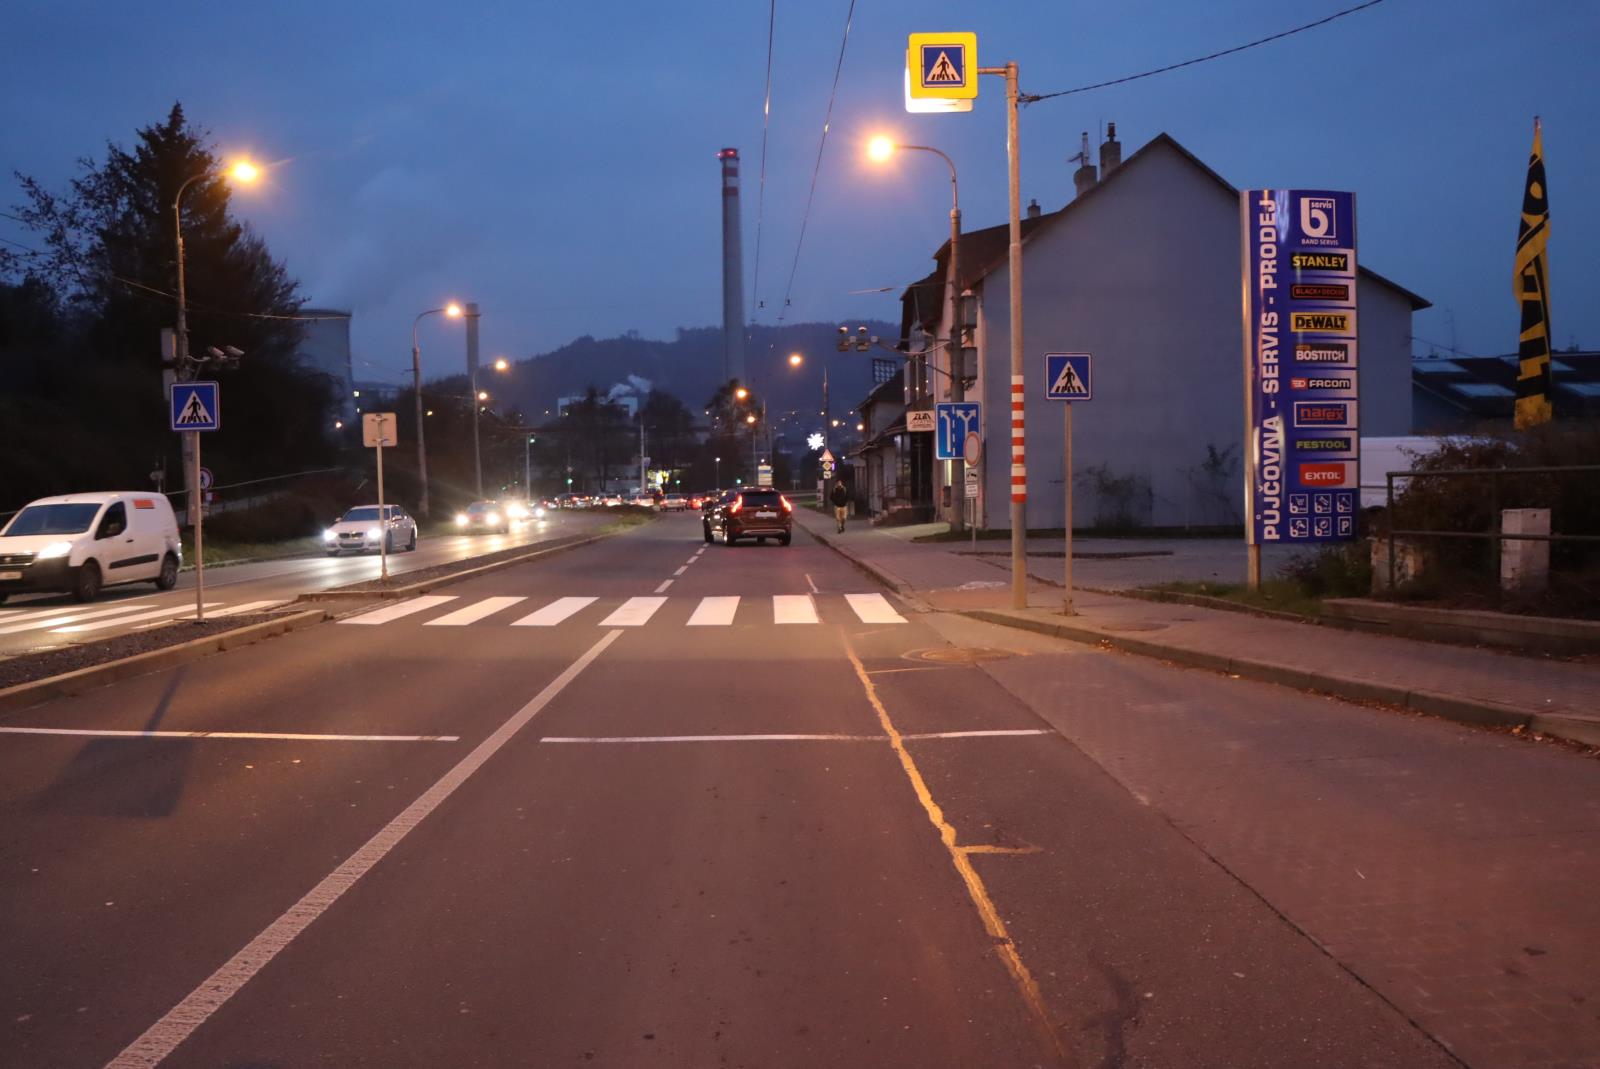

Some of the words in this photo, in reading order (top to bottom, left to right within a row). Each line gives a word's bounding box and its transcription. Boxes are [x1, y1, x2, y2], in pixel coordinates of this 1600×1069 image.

[1311, 201, 1333, 209] servis
[1259, 199, 1277, 289] PRODEJ
[1292, 255, 1345, 268] STANLEY
[1261, 312, 1279, 394] SERVIS
[1296, 350, 1345, 361] BOSTITCH
[1309, 379, 1350, 388] FACOM
[1300, 407, 1344, 420] narex
[1296, 440, 1348, 449] FESTOOL
[1256, 415, 1280, 540] PŮJČOVNA
[1305, 471, 1341, 480] EXTOL
[1341, 520, 1349, 532] P
